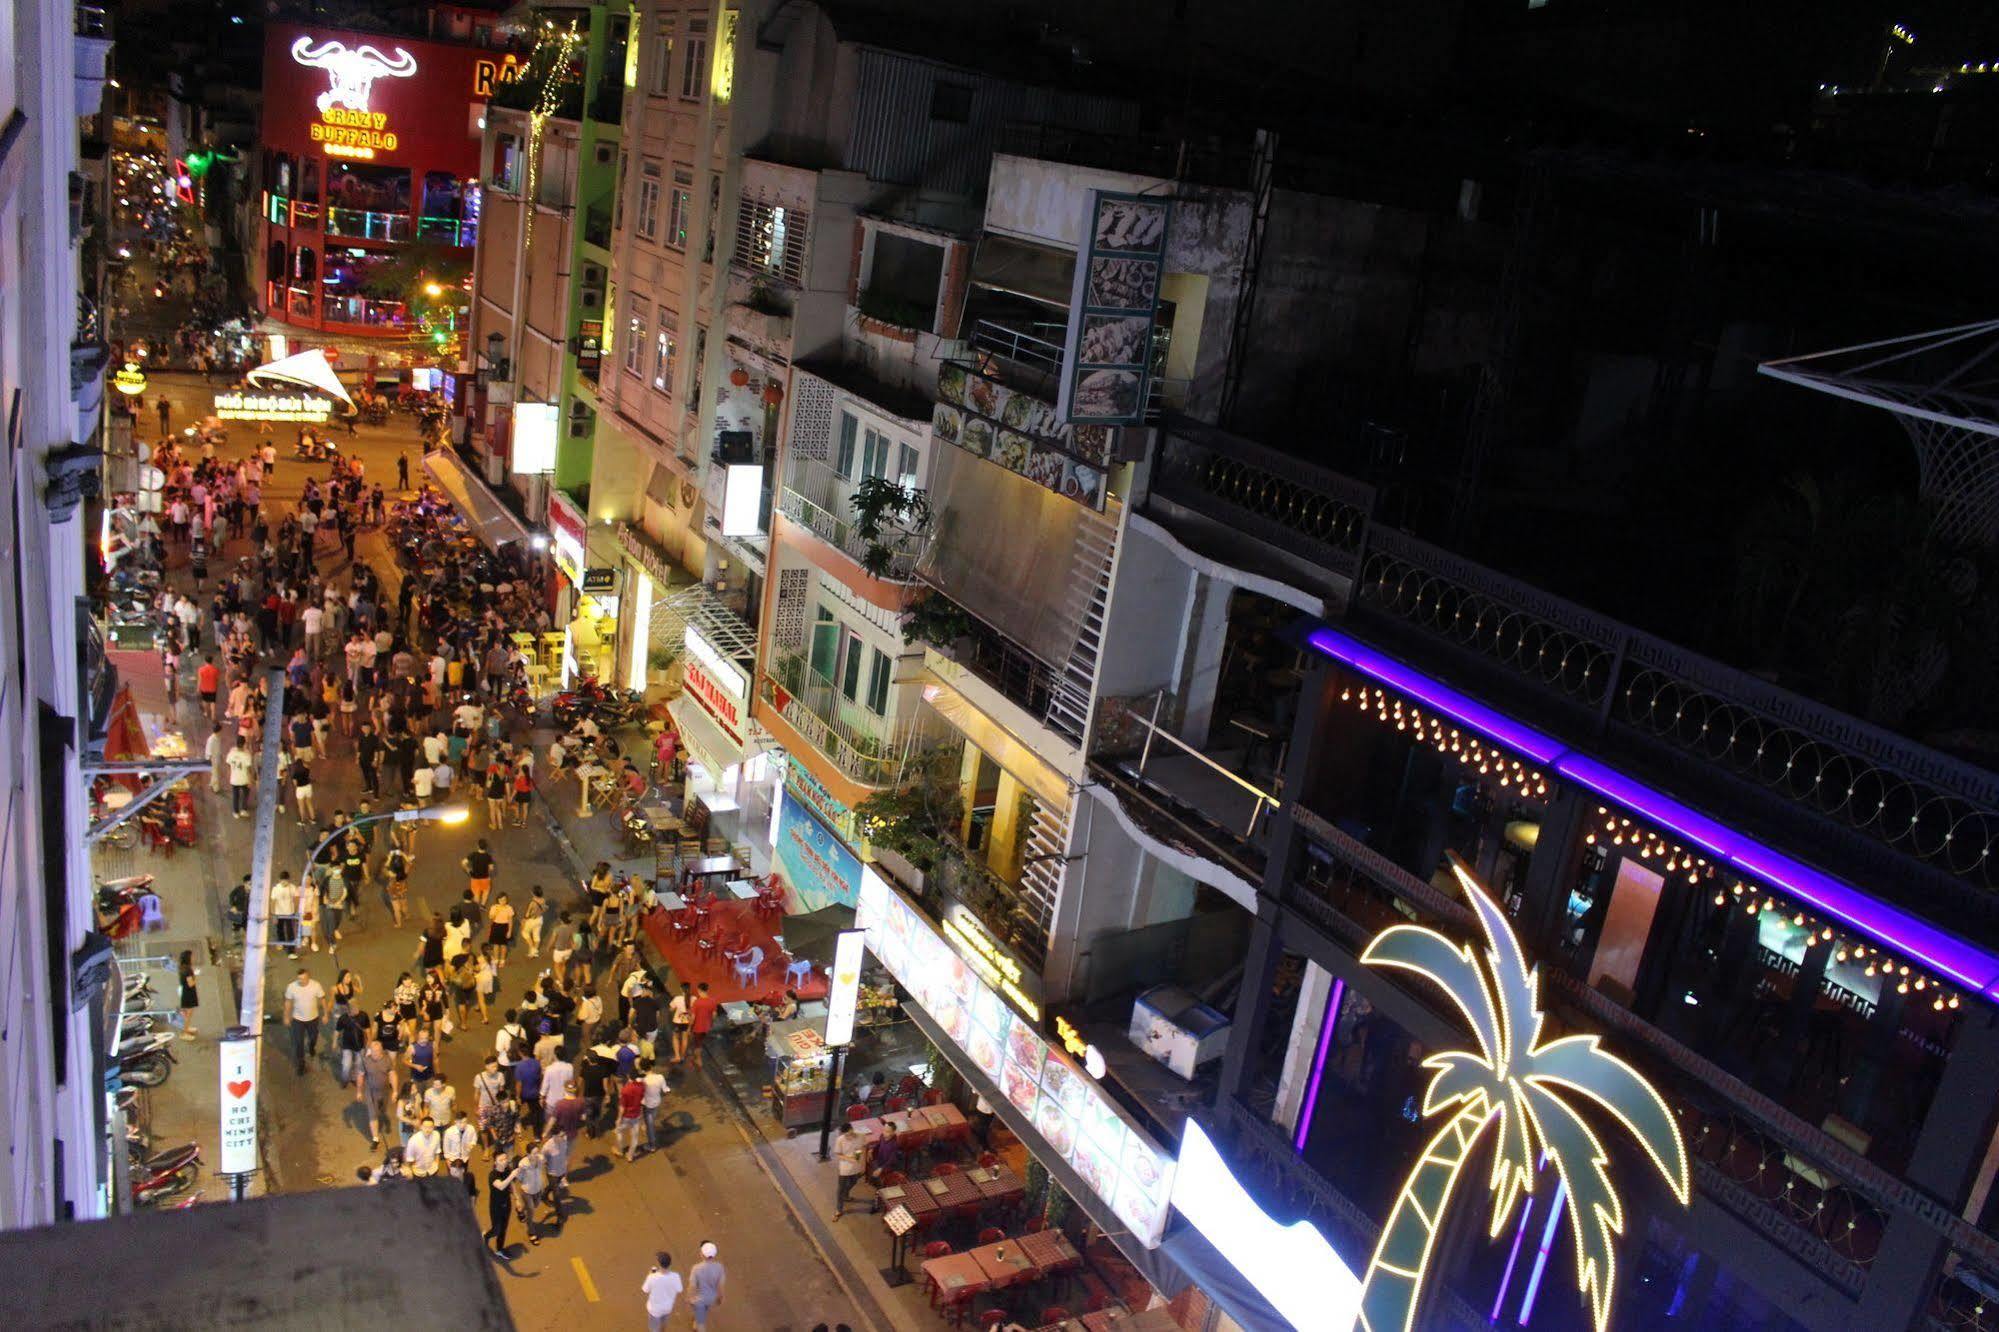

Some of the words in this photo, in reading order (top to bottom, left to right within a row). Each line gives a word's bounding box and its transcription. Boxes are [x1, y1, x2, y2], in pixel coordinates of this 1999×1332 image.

[474, 54, 527, 96] RÂ
[321, 107, 388, 131] CRAZY
[310, 122, 398, 151] BUFFALO
[687, 662, 706, 690] TAJ
[704, 679, 738, 727] MAHAL
[236, 1065, 242, 1075] I
[231, 1106, 248, 1115] HO
[229, 1117, 251, 1126] CHI
[225, 1126, 255, 1136] MINH
[226, 1138, 254, 1147] CITY
